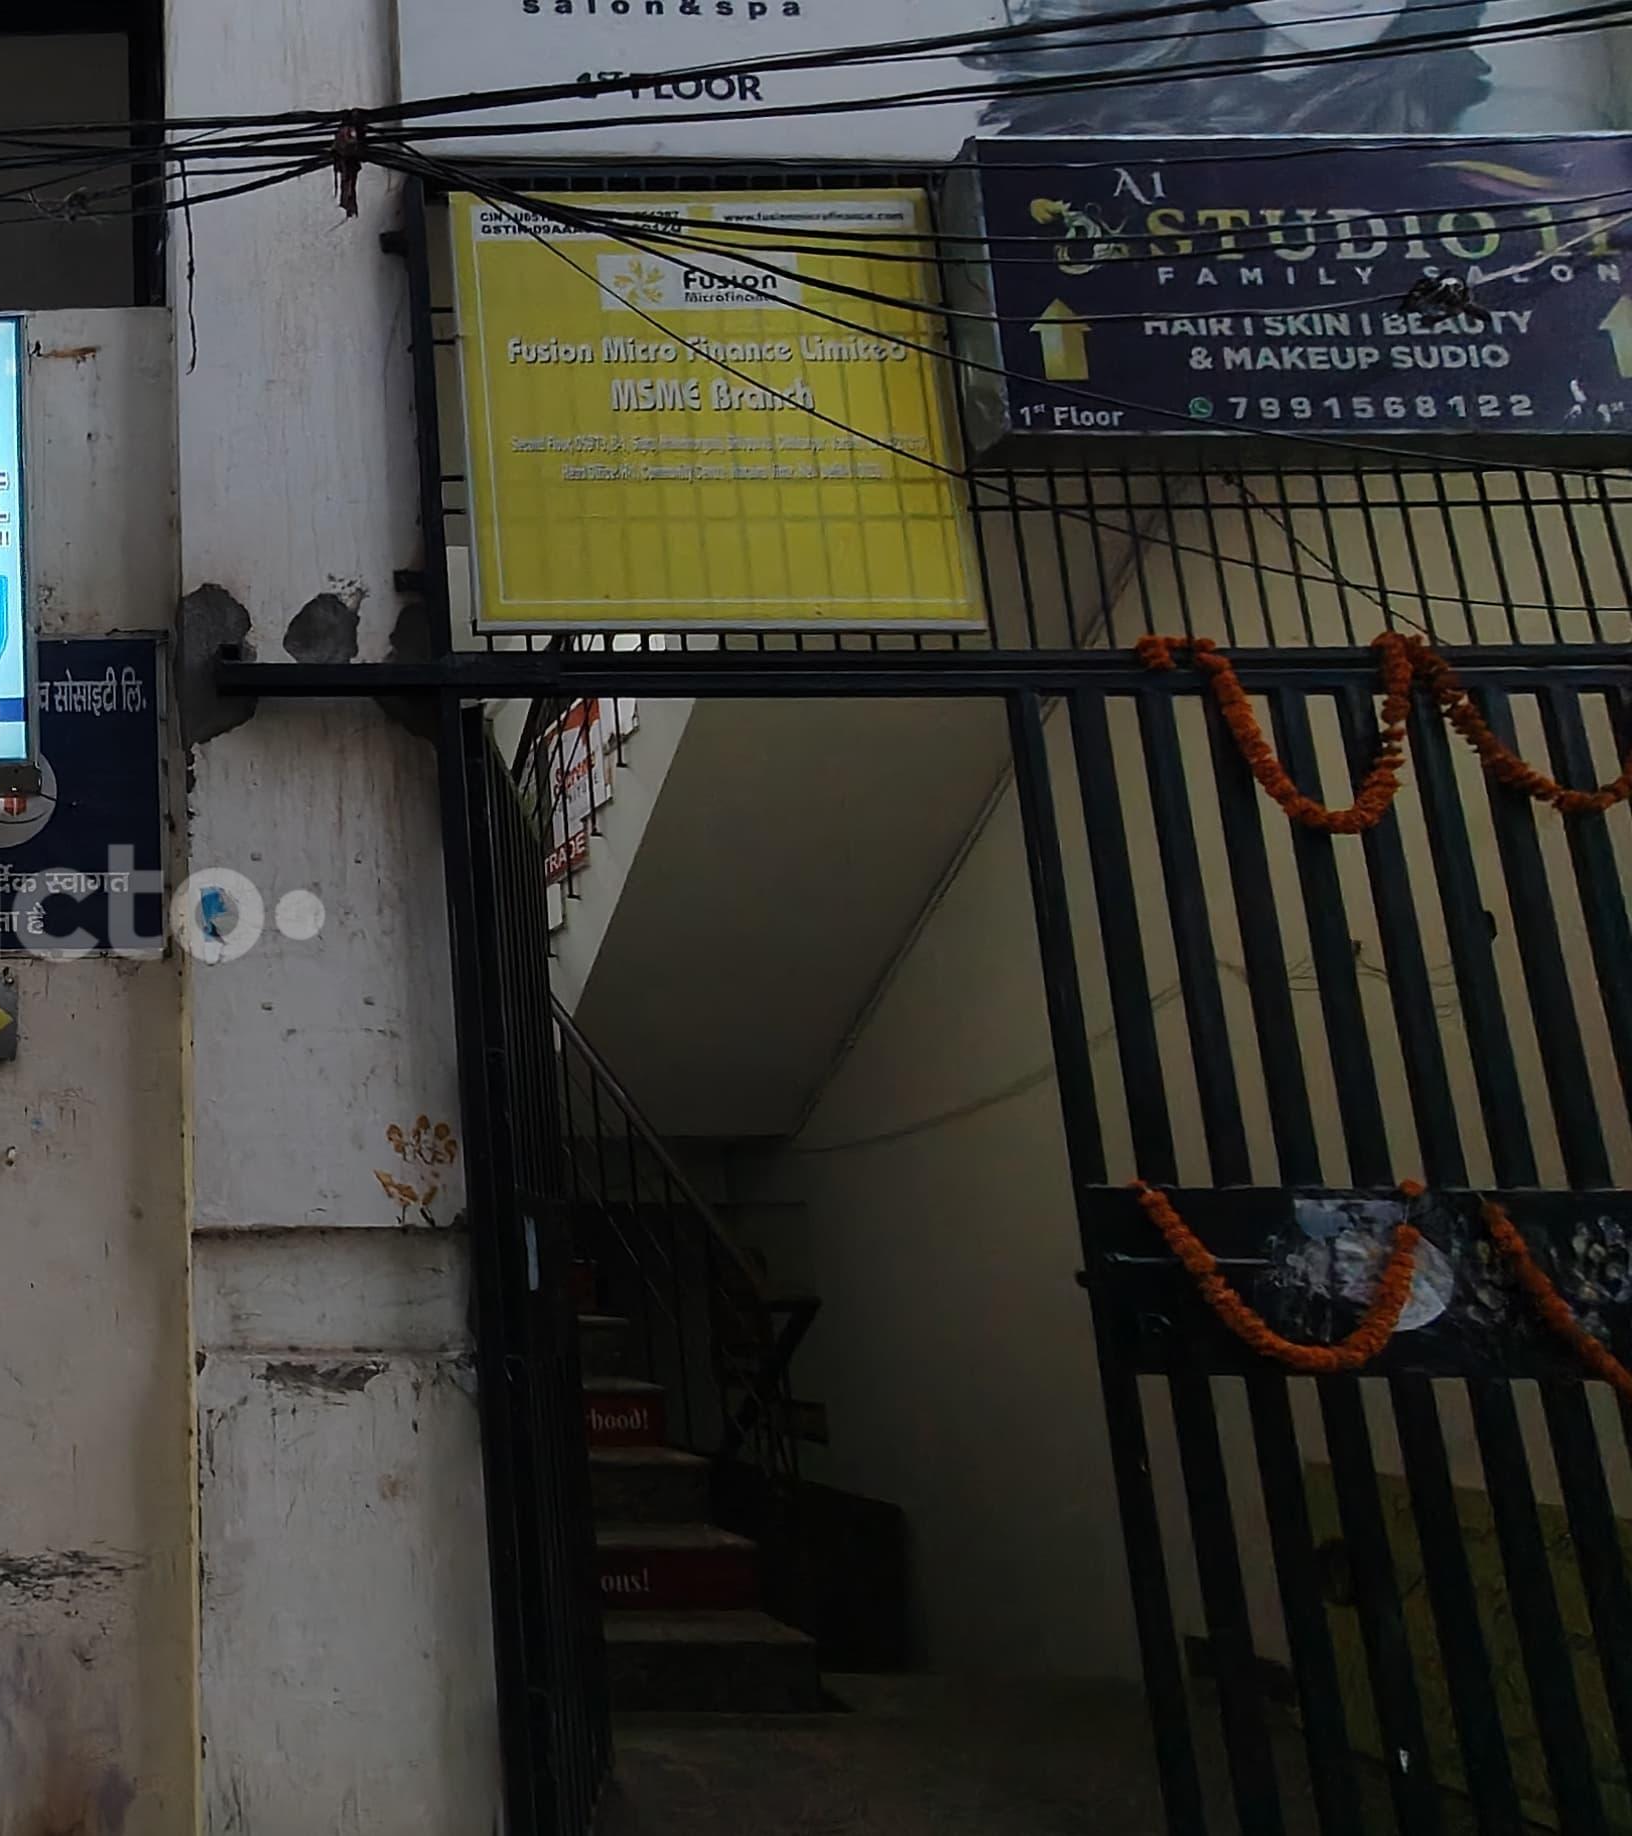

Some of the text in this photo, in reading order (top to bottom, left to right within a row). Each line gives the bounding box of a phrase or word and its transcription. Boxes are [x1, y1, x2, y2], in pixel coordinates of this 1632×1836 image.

[1145, 207, 1502, 262] STUDIO
[1157, 266, 1374, 286] FAMILY
[1263, 313, 1352, 337] SKIN
[1382, 310, 1534, 336] BEAUTY
[508, 336, 595, 364] Fusion
[601, 335, 678, 364] Micro
[686, 336, 793, 363] Finance
[1189, 343, 1512, 371] & MAKEUP SUDIO
[710, 378, 817, 412] Branch
[1226, 394, 1535, 420] 7991568122
[1053, 406, 1125, 428] Floor
[53, 666, 117, 717] सोसाइटी
[121, 666, 147, 713] लि.
[45, 871, 130, 894] स्वागत
